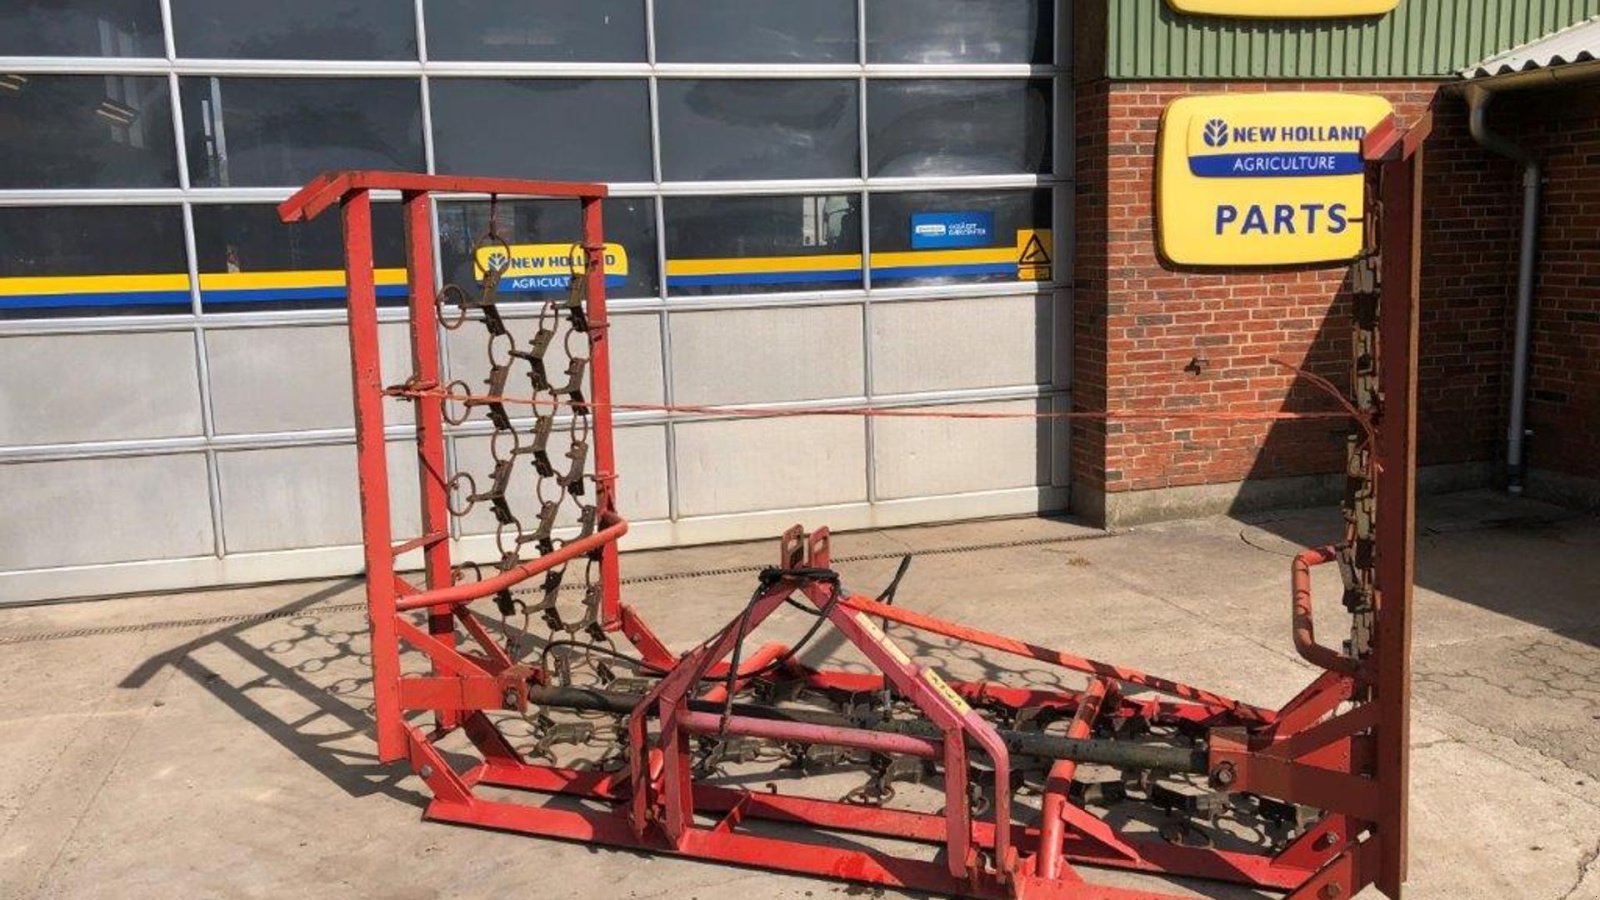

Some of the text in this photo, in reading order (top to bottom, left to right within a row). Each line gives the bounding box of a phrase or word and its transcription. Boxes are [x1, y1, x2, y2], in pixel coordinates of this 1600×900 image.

[1233, 125, 1367, 143] NEW HOLLAND
[1232, 155, 1336, 172] AGRICULTURE
[1215, 203, 1347, 235] PARTS
[511, 254, 615, 269] NEW HOLLD
[511, 276, 571, 289] AGRICULT
